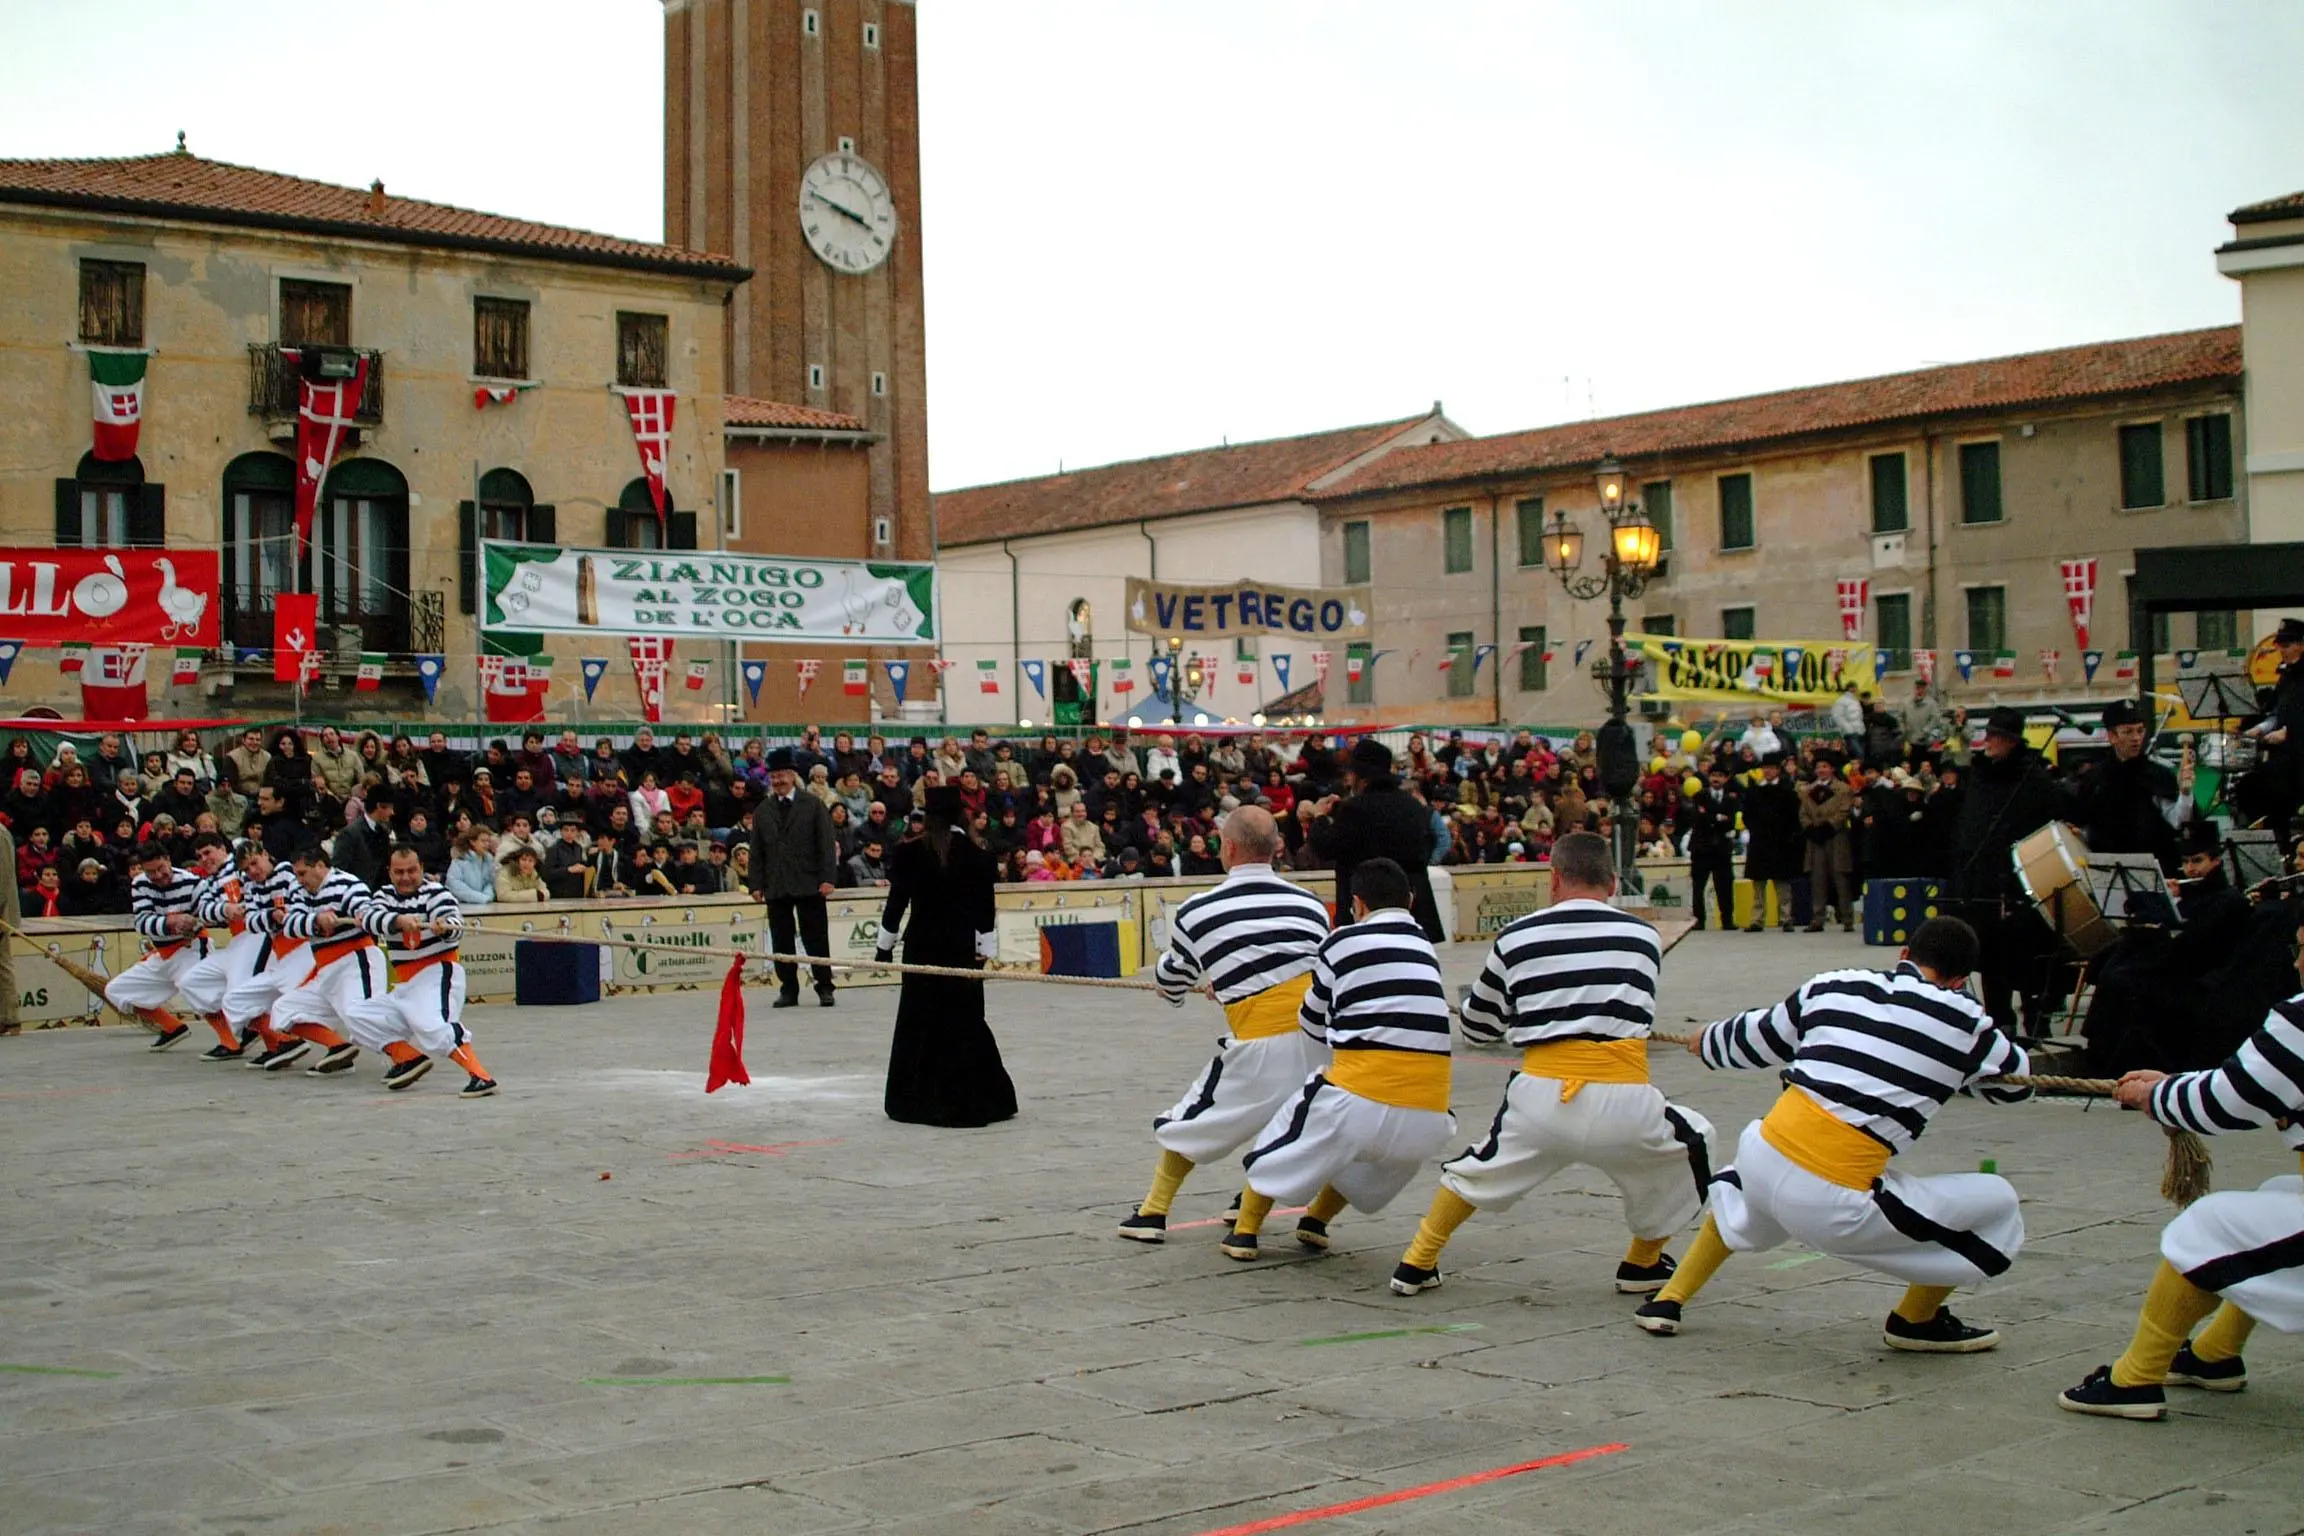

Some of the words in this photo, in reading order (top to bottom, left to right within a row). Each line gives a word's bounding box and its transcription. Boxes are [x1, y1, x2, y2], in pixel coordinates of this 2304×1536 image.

[610, 558, 825, 589] ZIANIGO
[632, 588, 680, 605] AL
[691, 586, 806, 609] ZOGO
[633, 608, 678, 626] DE
[1154, 589, 1345, 633] VETREGO
[622, 931, 717, 955] Vianello
[17, 988, 49, 1007] AS
